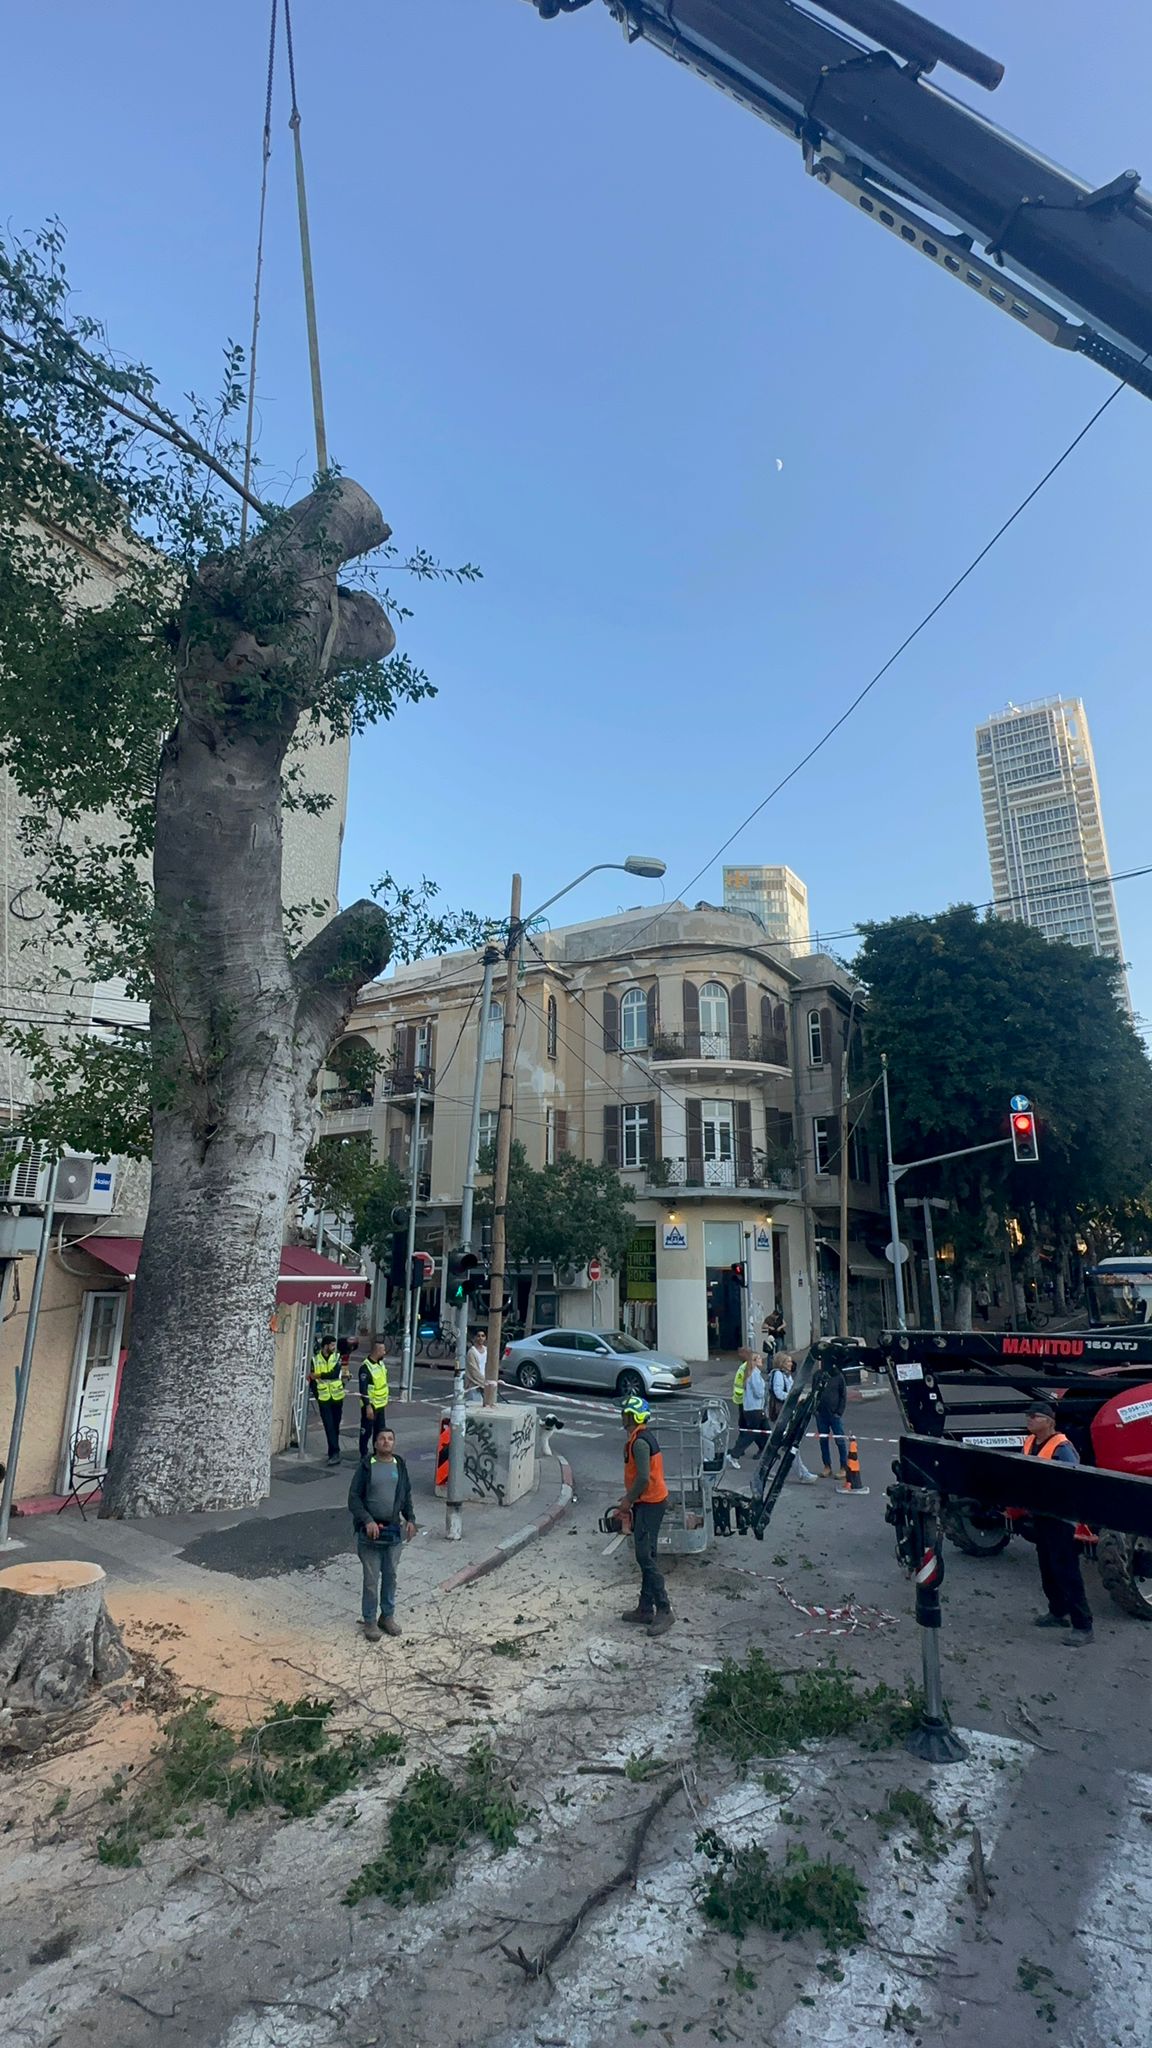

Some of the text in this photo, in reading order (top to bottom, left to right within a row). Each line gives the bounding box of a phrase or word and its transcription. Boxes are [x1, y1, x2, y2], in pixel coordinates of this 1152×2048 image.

[628, 1254, 651, 1266] THEM
[628, 1269, 651, 1280] HOME
[1002, 1338, 1084, 1355] MANITOU
[1113, 1341, 1138, 1350] ATJ
